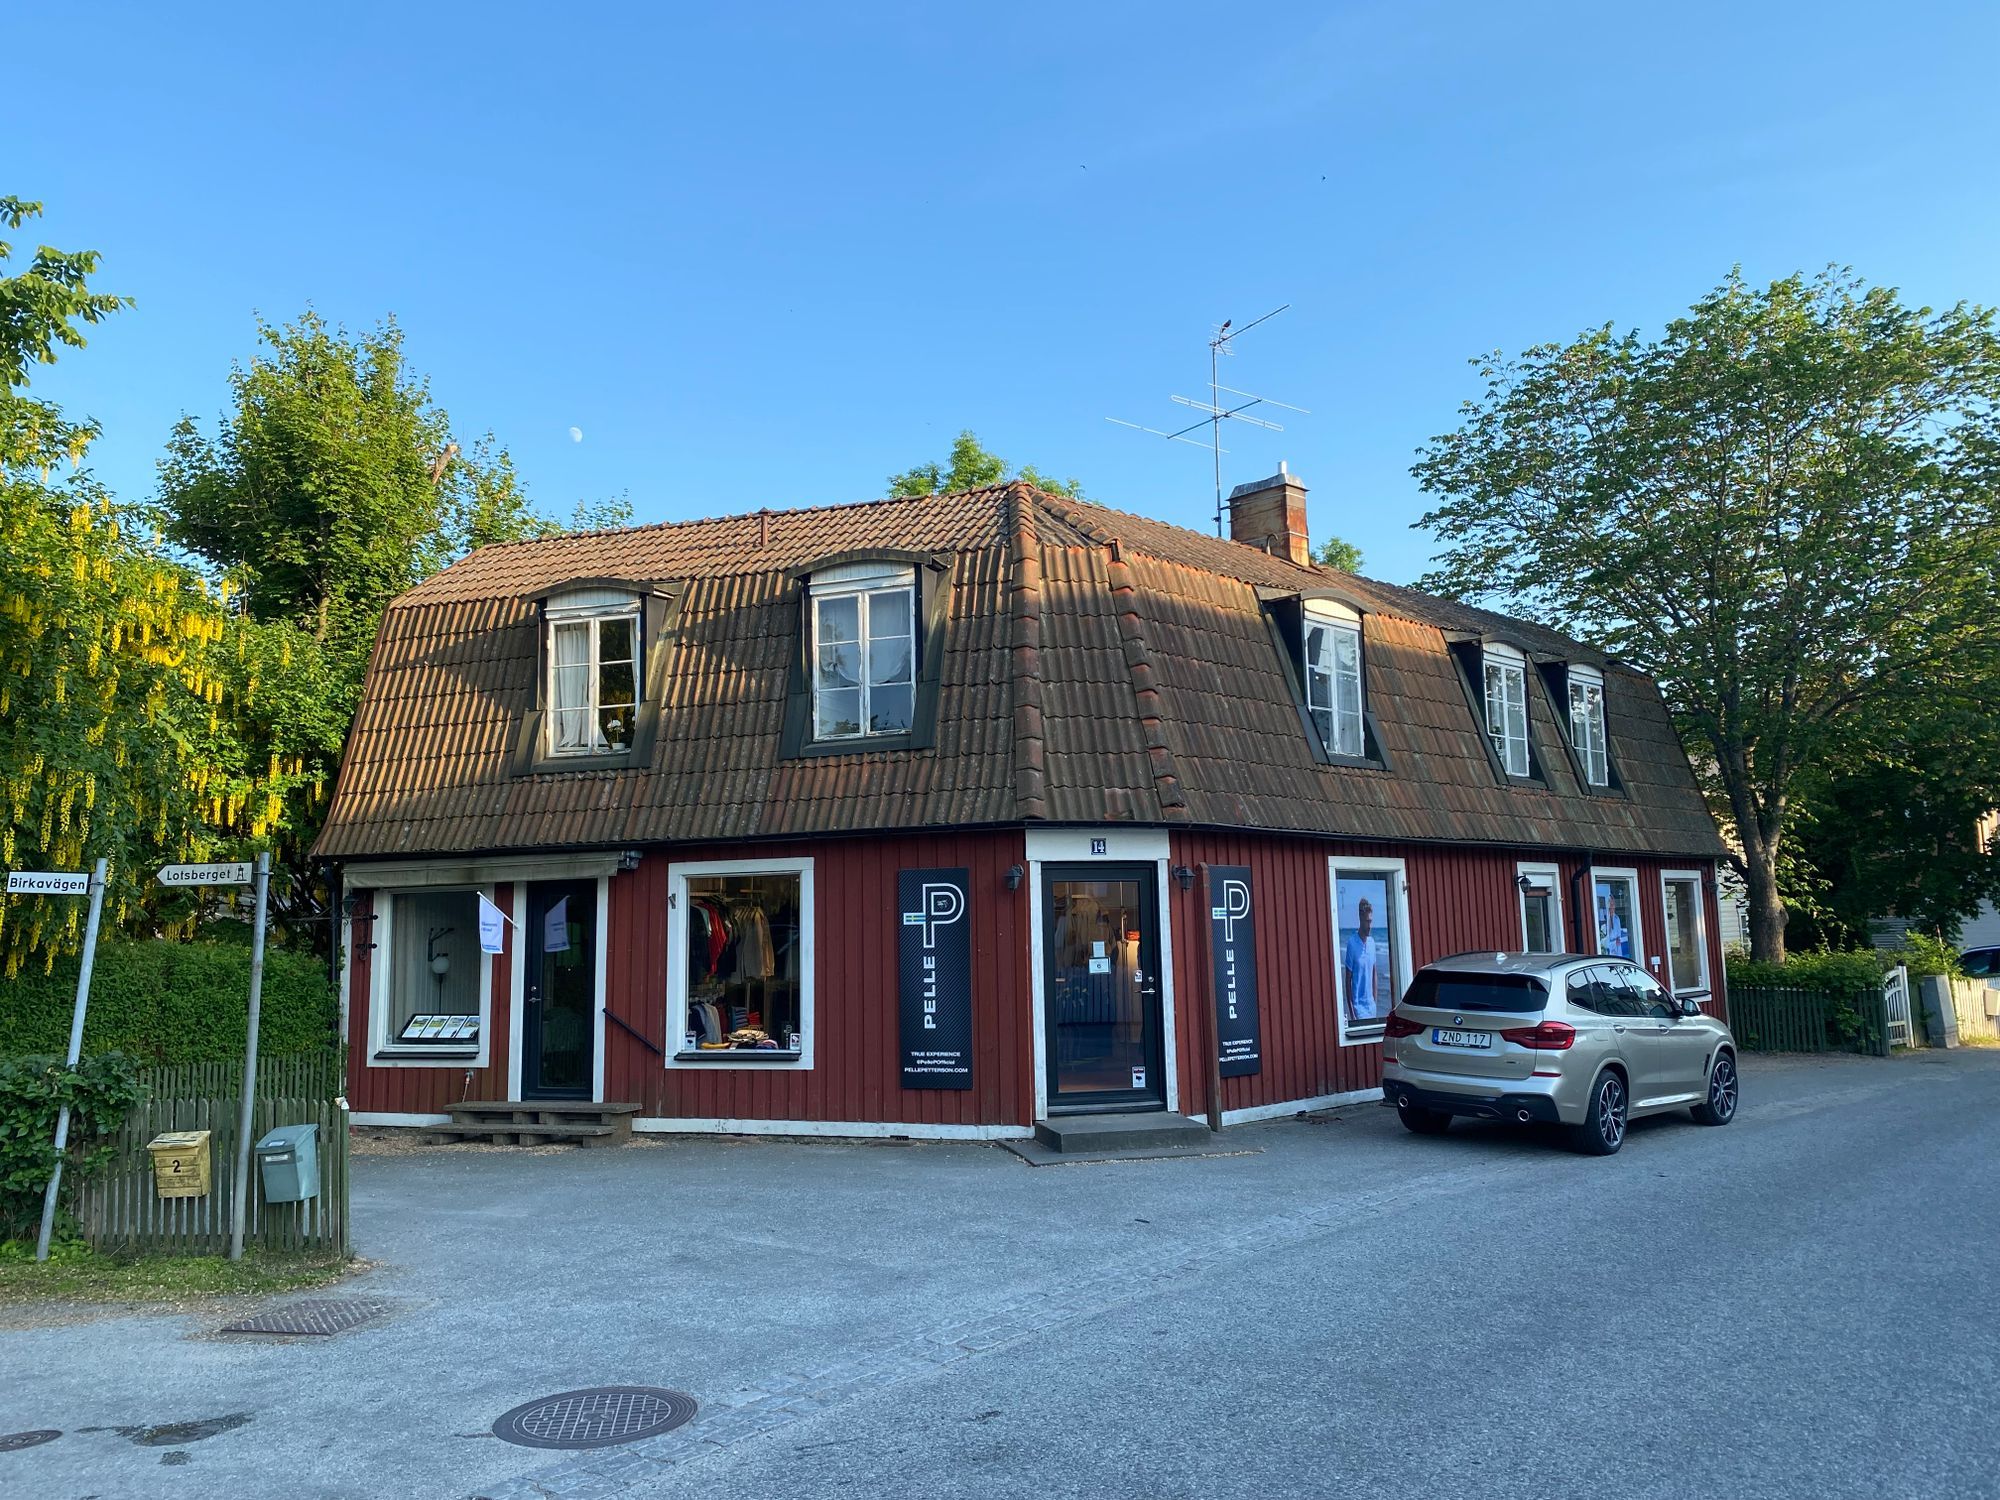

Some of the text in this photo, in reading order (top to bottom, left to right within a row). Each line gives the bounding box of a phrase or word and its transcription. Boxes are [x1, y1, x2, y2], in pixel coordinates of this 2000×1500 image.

[1093, 840, 1105, 853] 14
[166, 869, 231, 882] Lotsberget
[9, 877, 85, 892] Birkavägen
[1226, 949, 1238, 1019] PELLE
[923, 955, 936, 1029] PELLE
[1442, 1031, 1462, 1043] ZND
[1466, 1033, 1486, 1045] 117
[172, 1159, 181, 1173] 2
